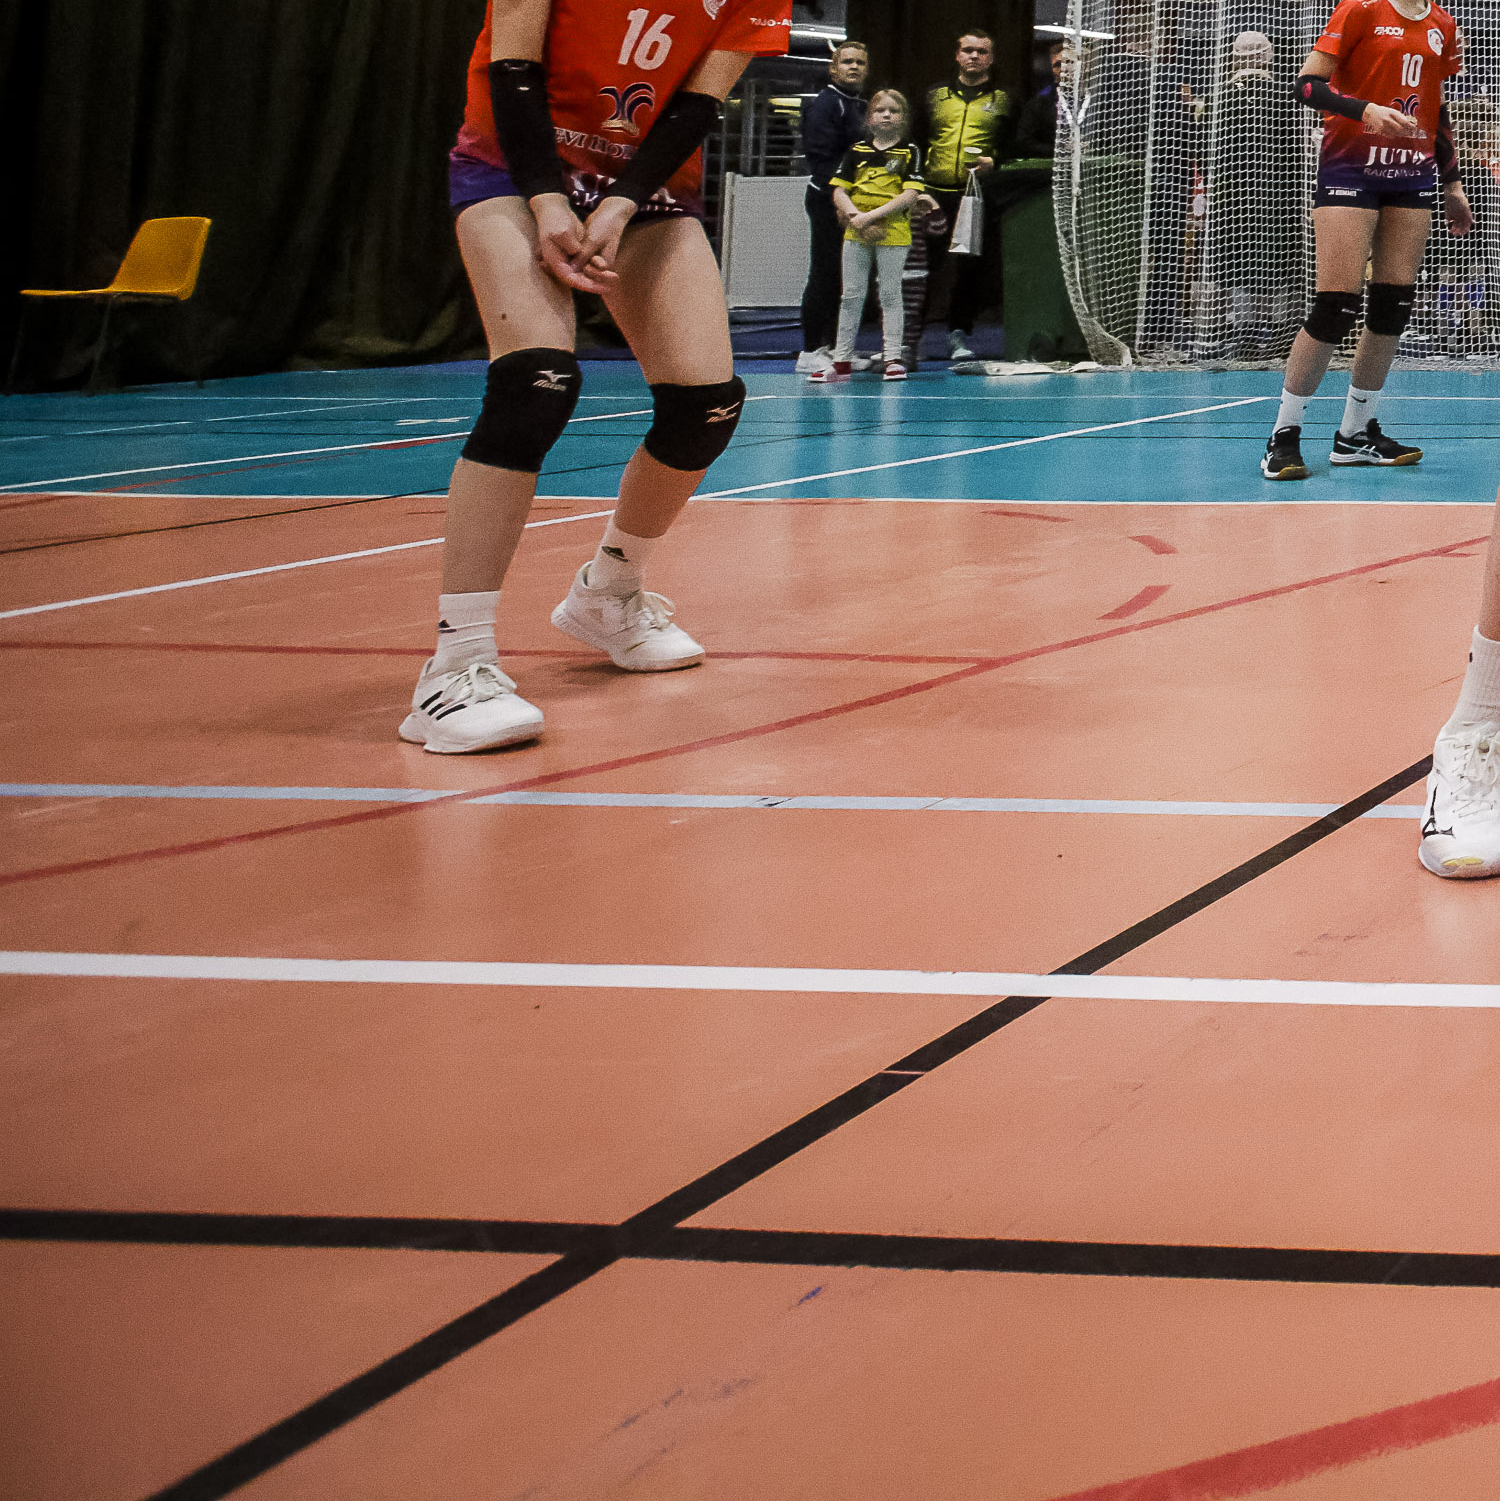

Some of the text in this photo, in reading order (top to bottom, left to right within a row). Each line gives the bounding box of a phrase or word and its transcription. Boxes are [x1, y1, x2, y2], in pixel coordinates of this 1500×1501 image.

[617, 7, 676, 70] 16
[1401, 52, 1424, 88] 10
[1365, 145, 1426, 166] JUTO
